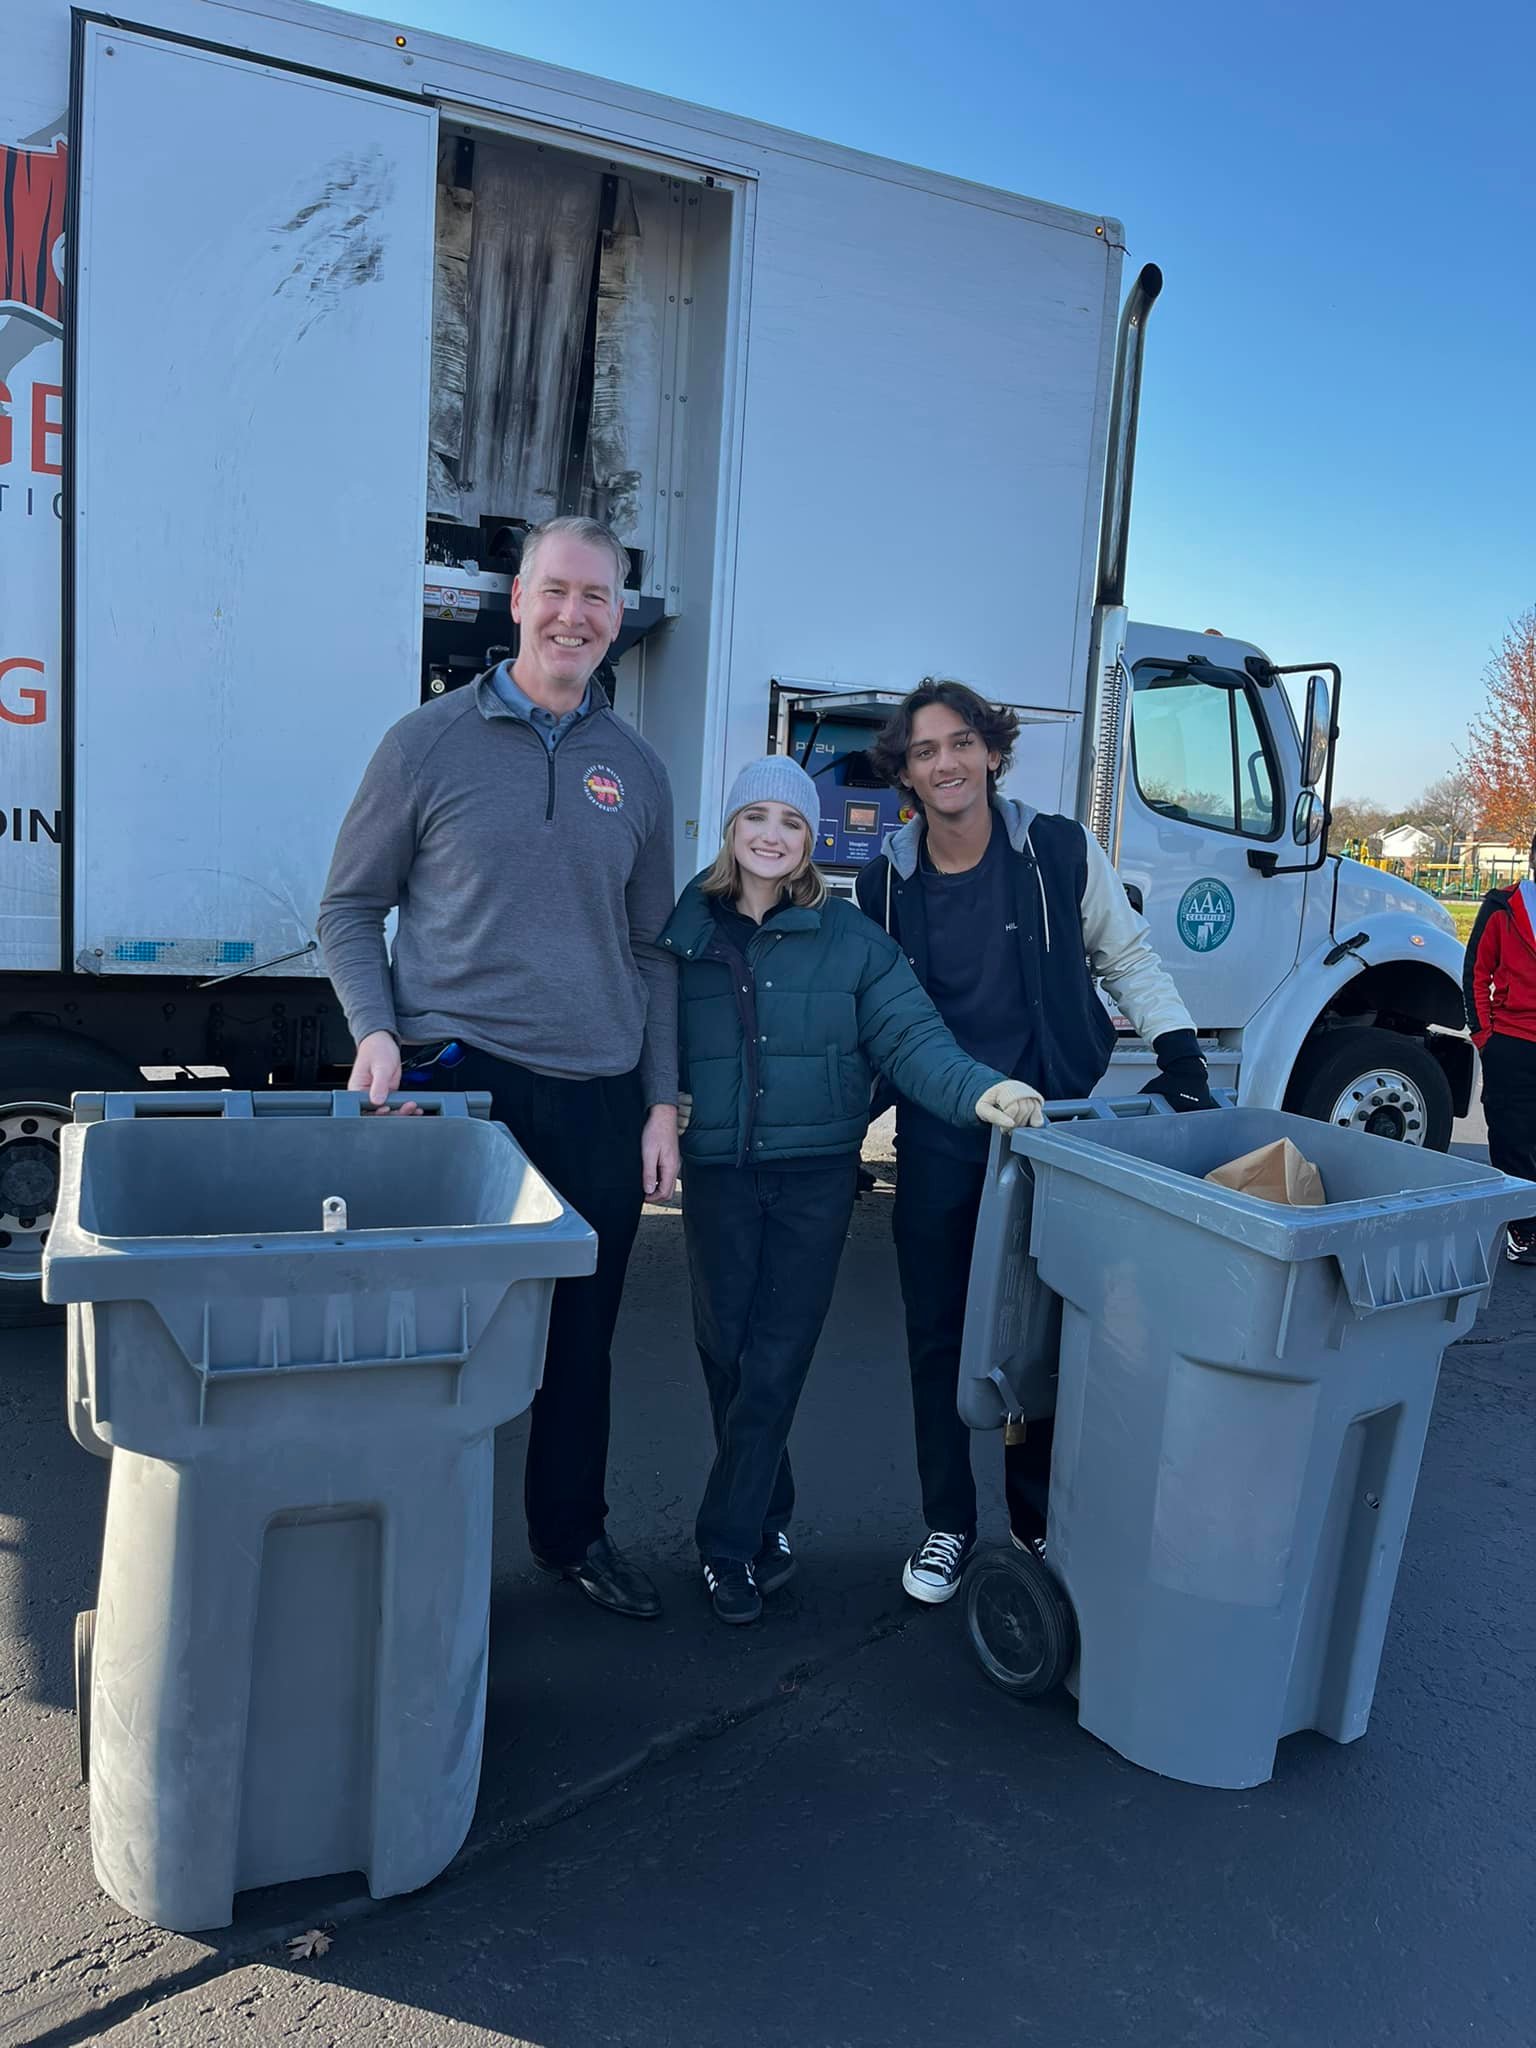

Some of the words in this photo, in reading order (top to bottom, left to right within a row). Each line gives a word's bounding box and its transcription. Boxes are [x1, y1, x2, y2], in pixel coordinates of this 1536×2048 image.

[795, 741, 835, 754] P24
[0, 807, 63, 843] IN
[1188, 891, 1225, 913] AAA
[1186, 913, 1226, 921] CERTIFIED
